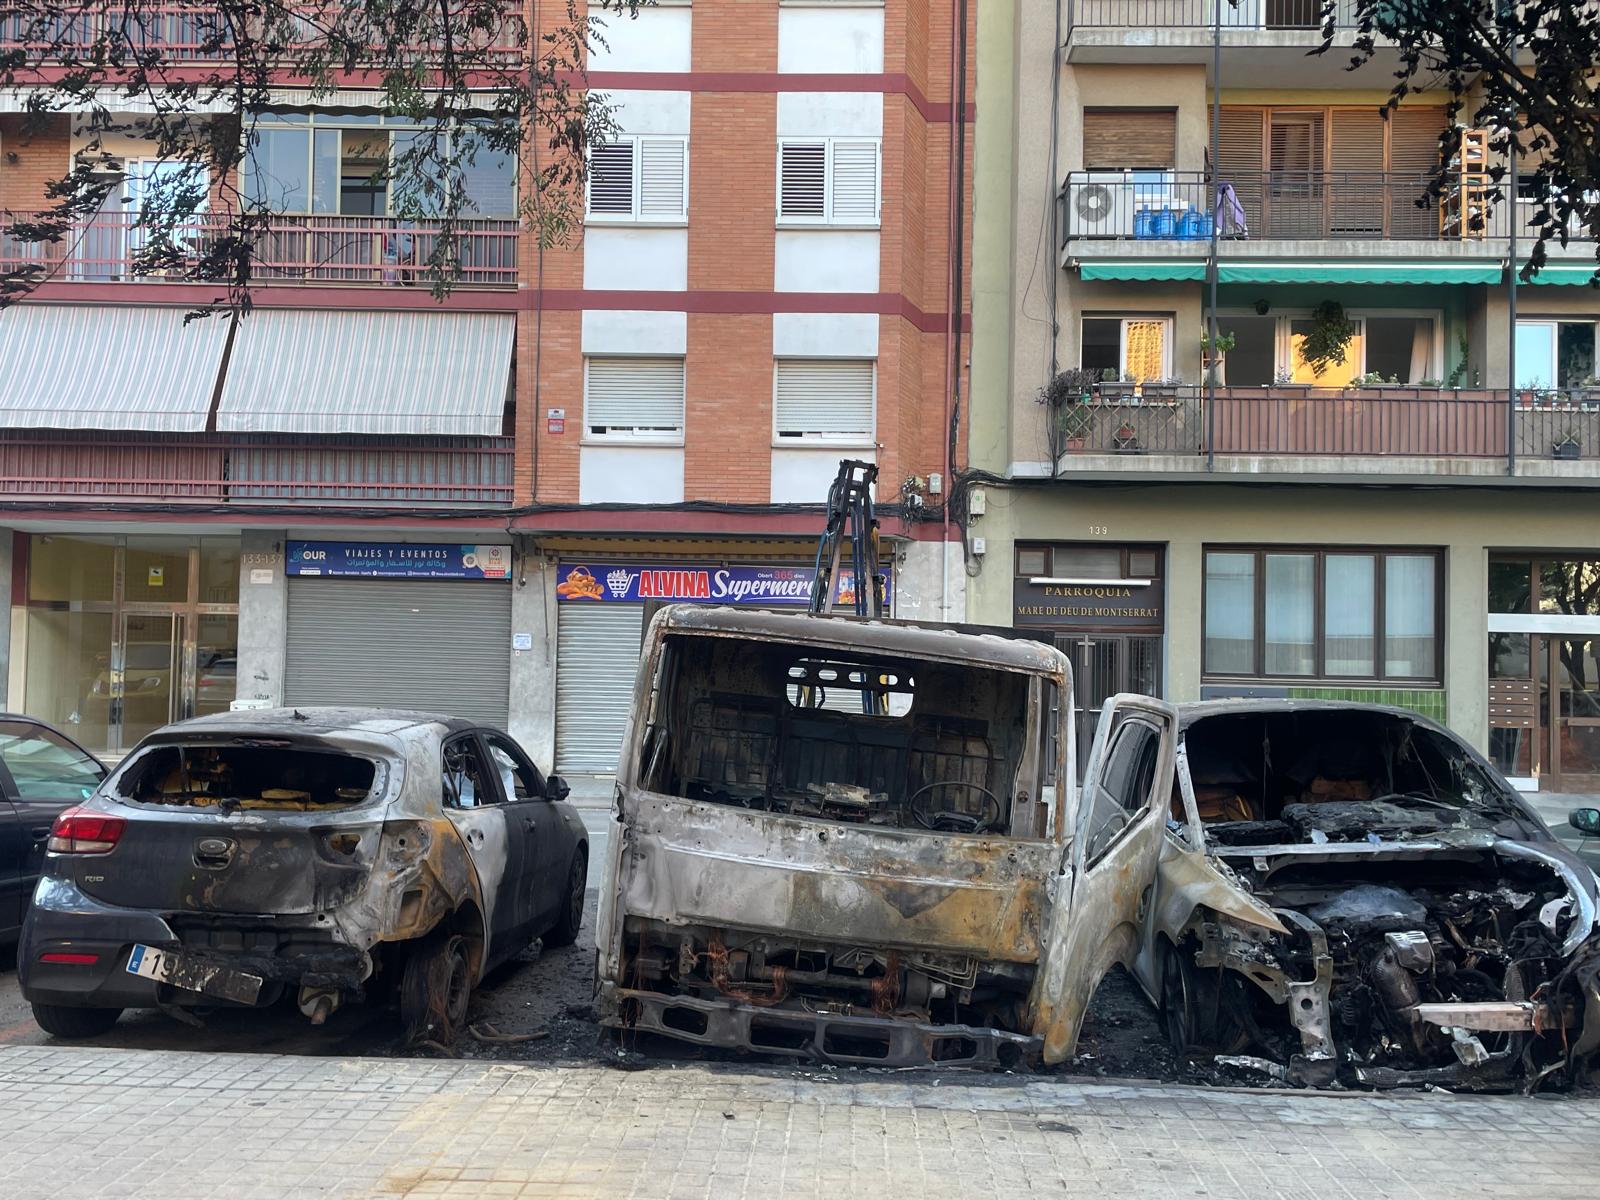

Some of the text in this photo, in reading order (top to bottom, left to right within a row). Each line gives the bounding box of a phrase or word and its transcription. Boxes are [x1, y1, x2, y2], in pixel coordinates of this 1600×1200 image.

[1088, 526, 1108, 535] 139
[243, 553, 282, 564] 133-137
[345, 549, 448, 559] VIAJES Y EVENTOS
[774, 571, 794, 580] 365
[638, 570, 828, 601] ALVINA Supermerc
[1044, 586, 1131, 598] PARROQUIA
[1017, 606, 1044, 615] MARE
[1046, 607, 1058, 616] DE
[1081, 607, 1093, 617] DE
[1095, 607, 1159, 618] MONTSERRAT
